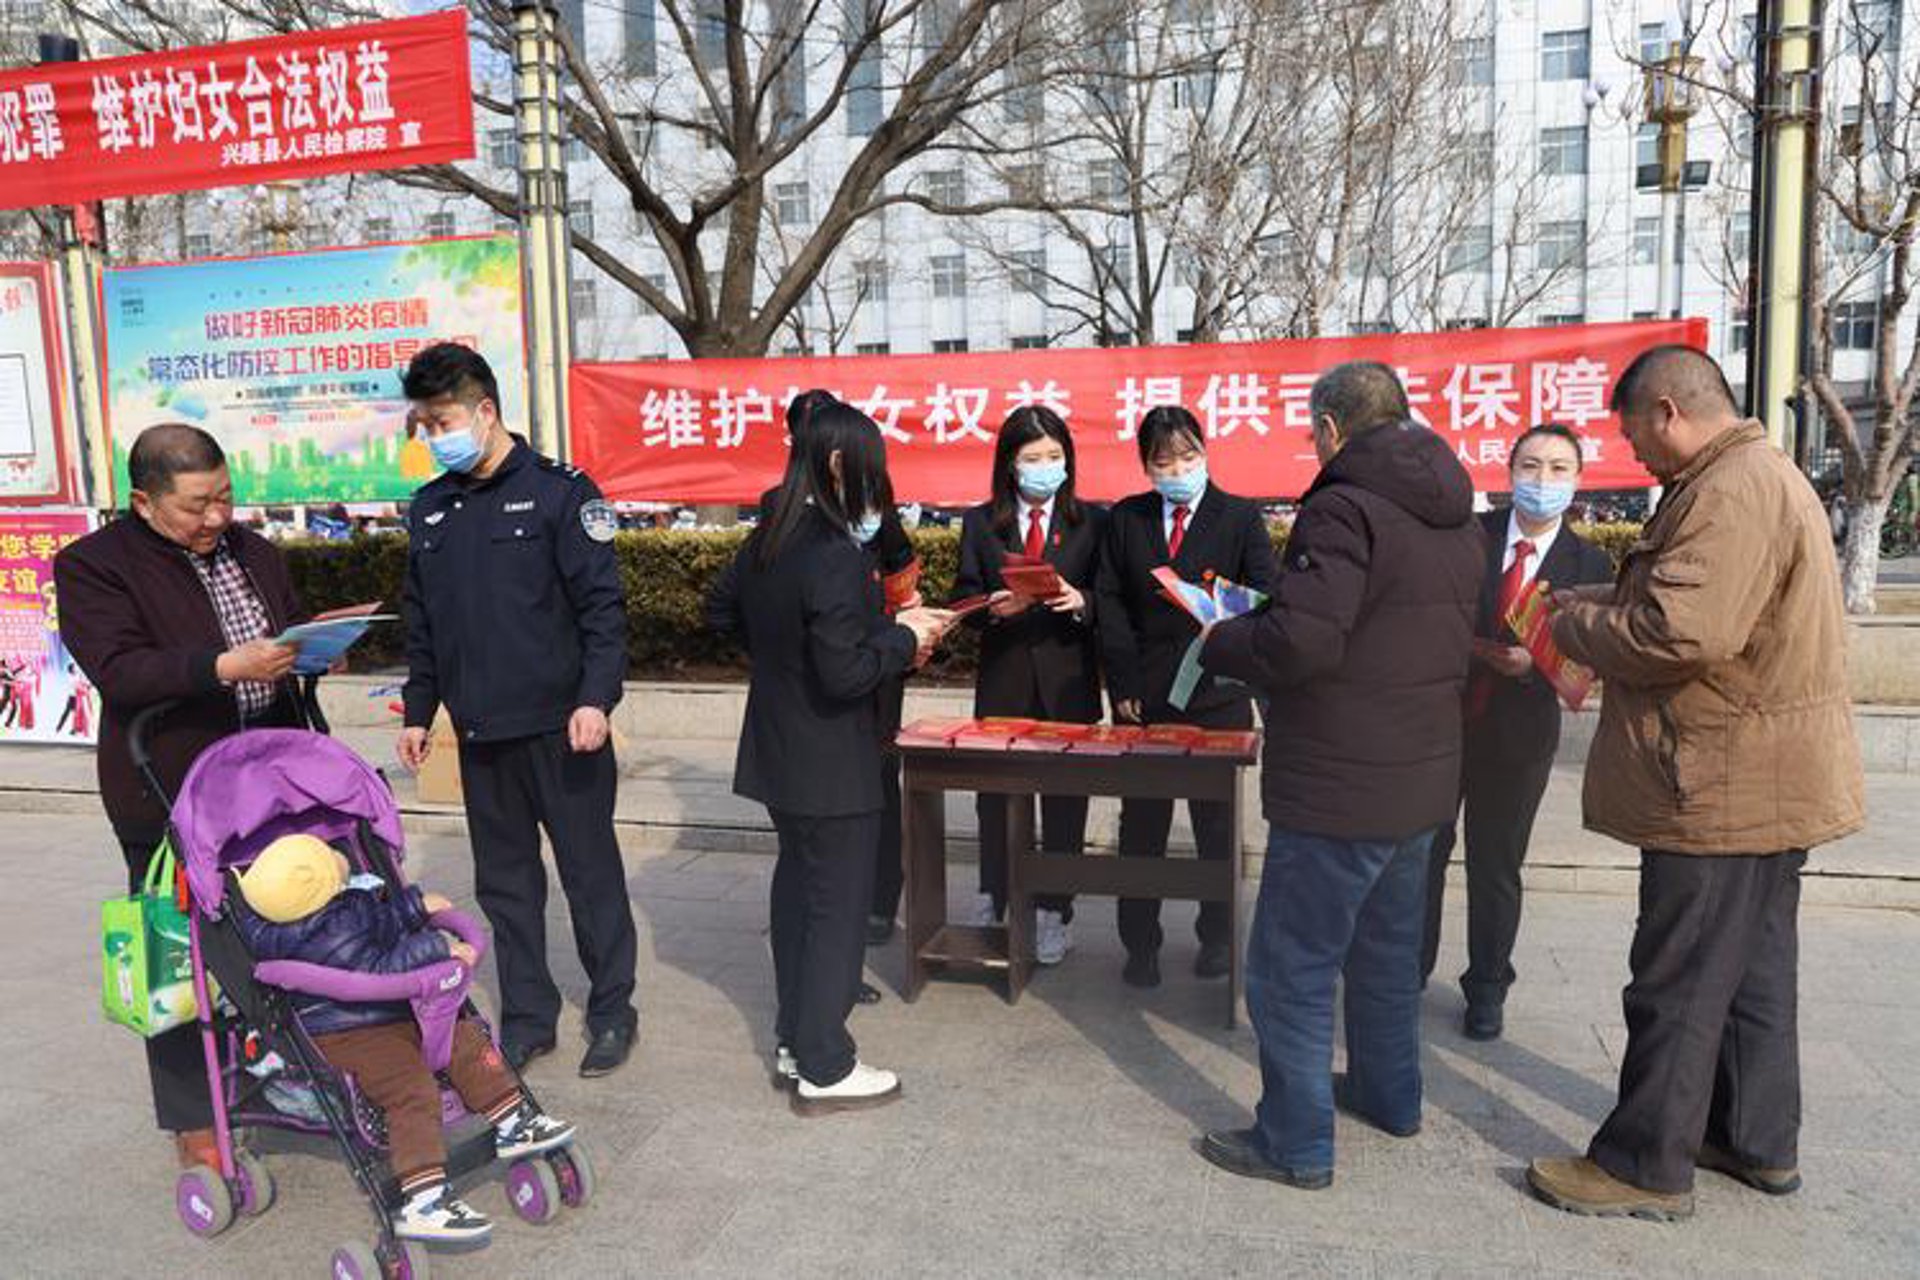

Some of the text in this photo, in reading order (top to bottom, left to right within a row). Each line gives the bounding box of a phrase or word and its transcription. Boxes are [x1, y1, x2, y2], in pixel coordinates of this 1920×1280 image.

[92, 40, 395, 153] 维护妇女合法权益
[221, 126, 388, 167] 兴隆县人民检察院
[205, 297, 428, 341] 做好新冠肺炎疫情
[148, 334, 477, 382] 常态化防控工作的指导
